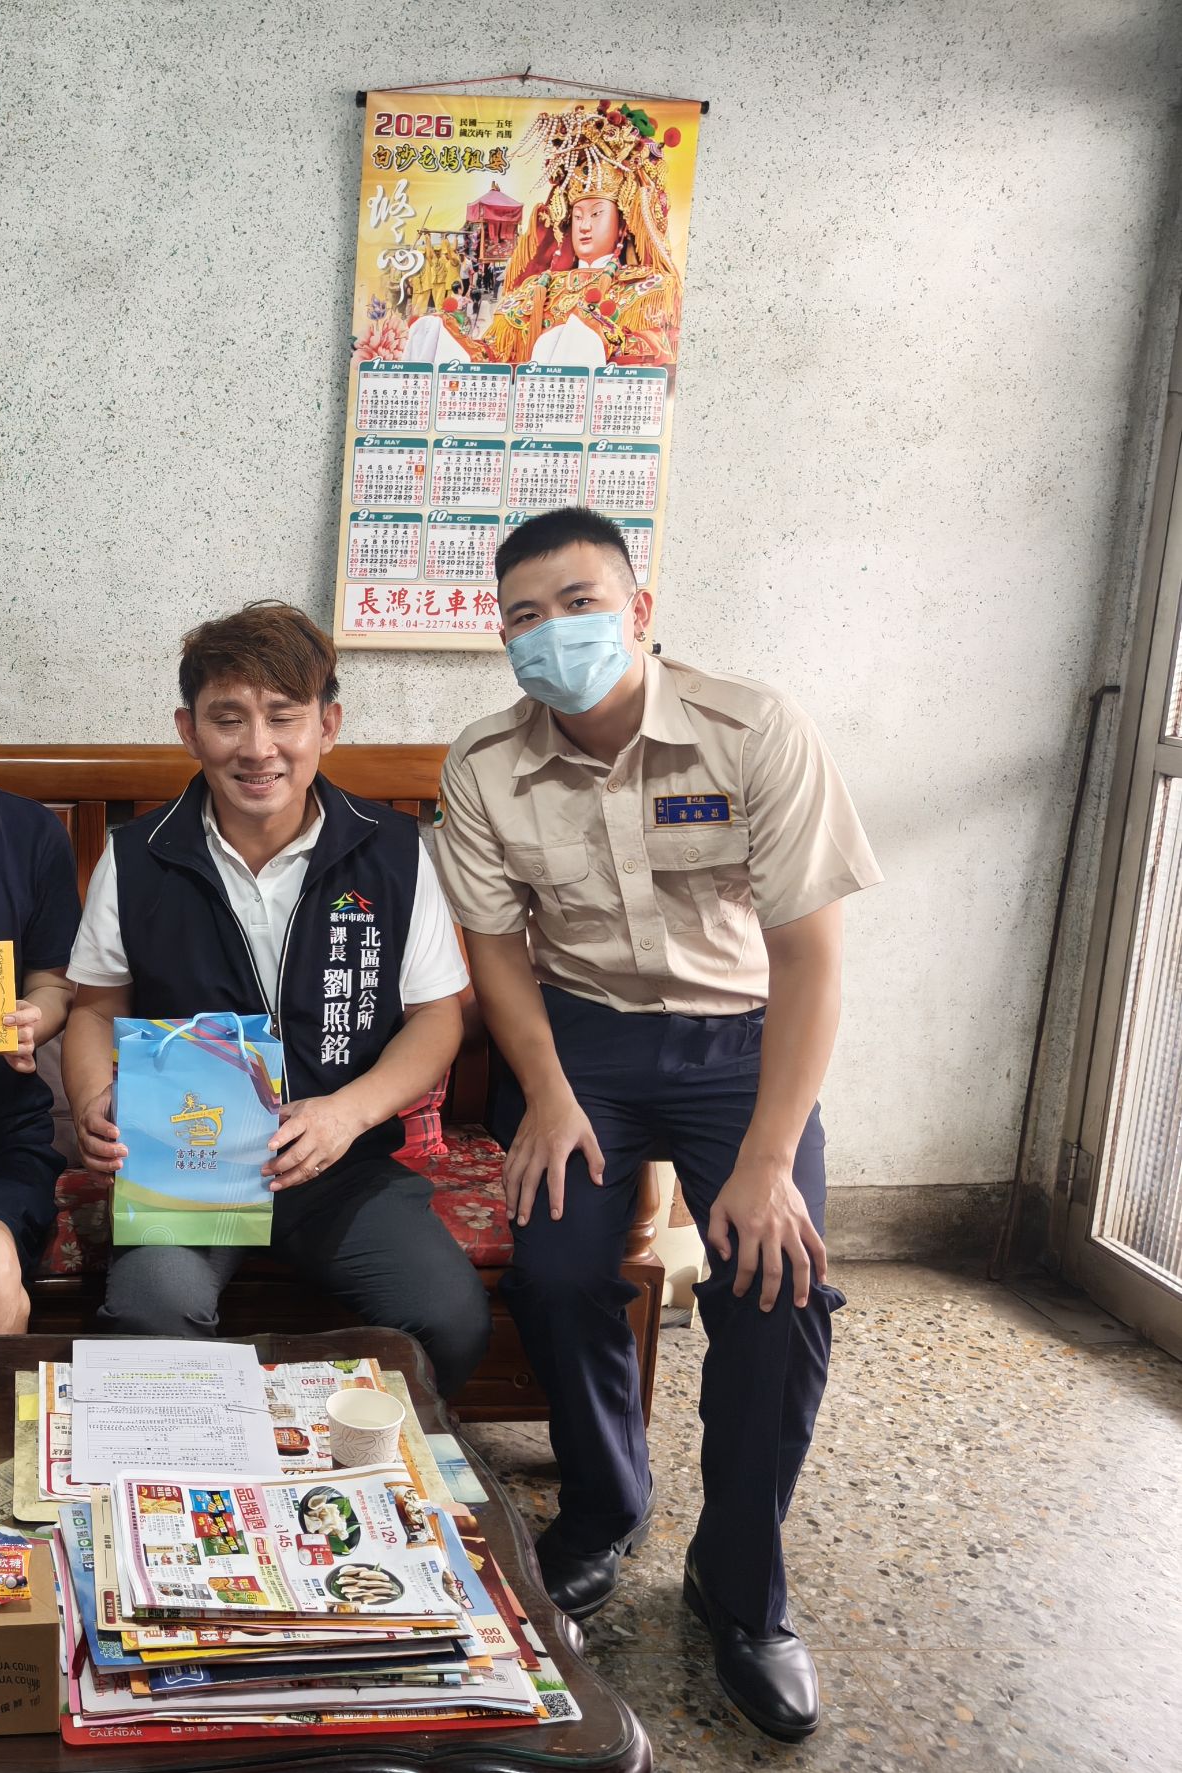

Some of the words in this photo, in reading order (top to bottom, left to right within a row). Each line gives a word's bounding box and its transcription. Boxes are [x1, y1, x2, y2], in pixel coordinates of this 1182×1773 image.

[374, 112, 453, 138] 2026
[459, 118, 513, 128] 民國一一五年
[372, 144, 509, 174] 白沙屯媽祖婆
[358, 586, 498, 617] 長鴻汽車檢
[330, 912, 375, 923] 臺中市政府
[329, 926, 348, 962] 課長
[356, 926, 382, 1031] 北區區公所
[320, 968, 353, 1065] 劉照銘
[274, 1524, 293, 1548] $145
[89, 1729, 142, 1738] CALENDAR
